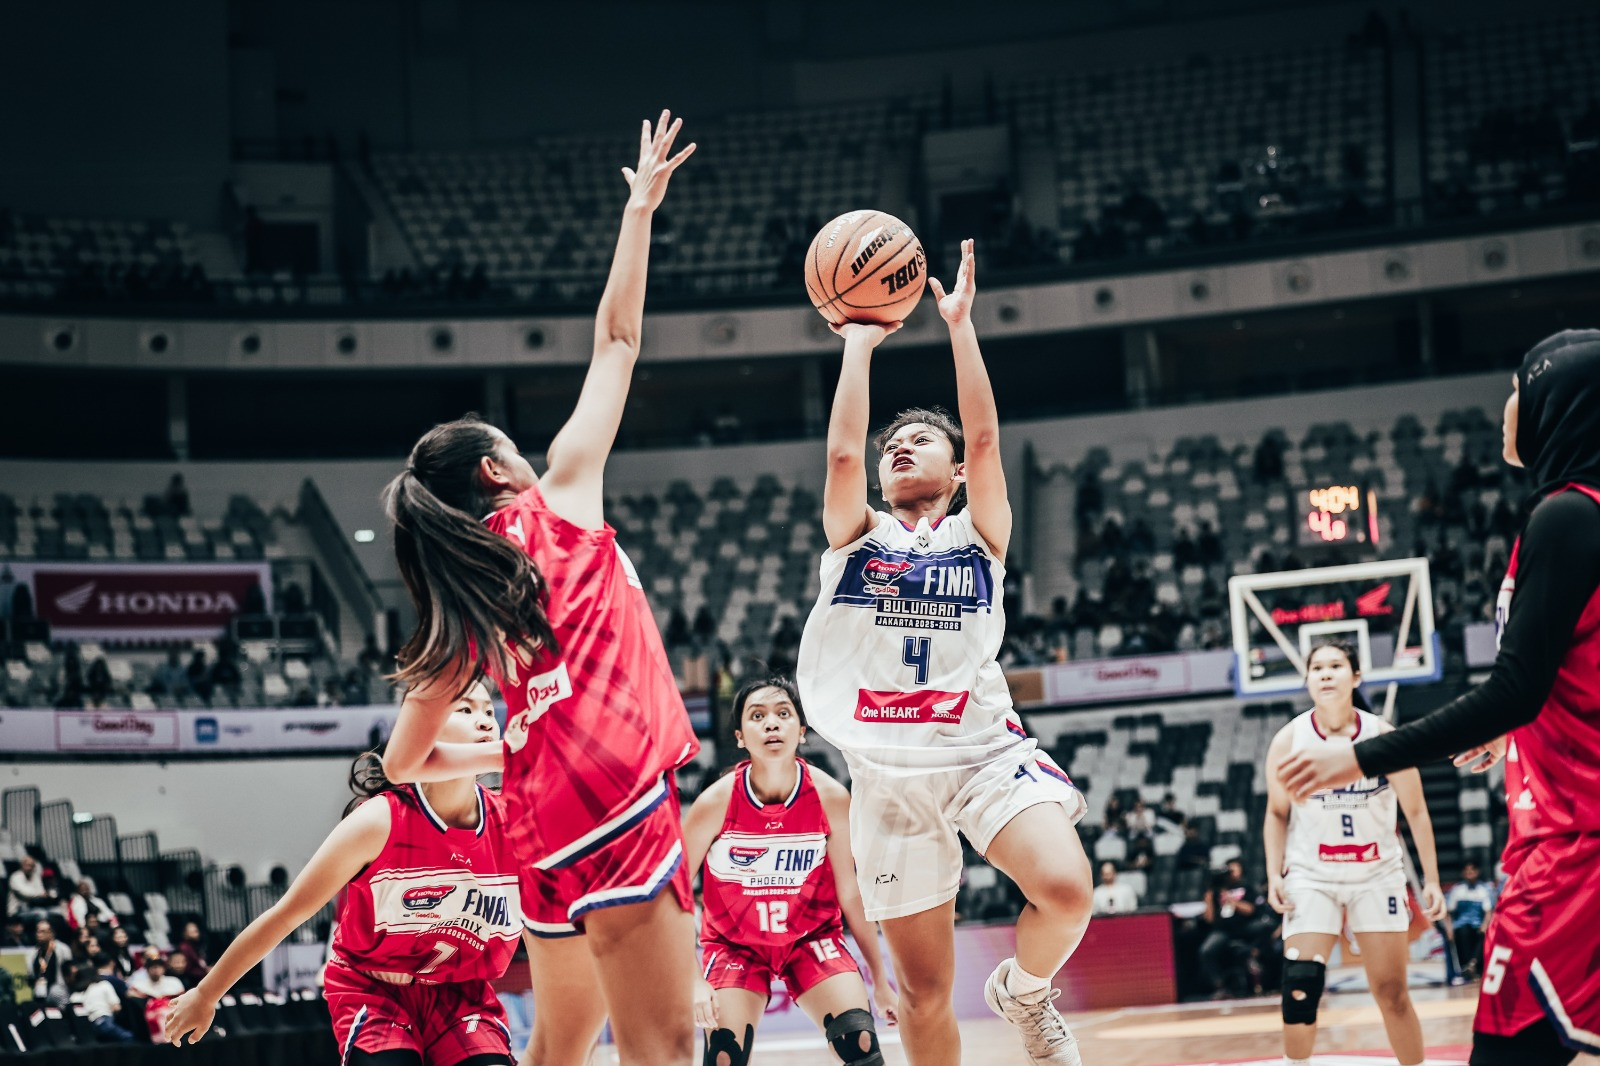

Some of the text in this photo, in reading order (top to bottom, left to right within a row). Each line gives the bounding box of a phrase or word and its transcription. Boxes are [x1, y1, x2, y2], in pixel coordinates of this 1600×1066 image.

[881, 264, 919, 296] DBL
[875, 572, 890, 581] DBL
[99, 591, 239, 614] HONDA
[883, 600, 956, 617] BULUNGAN
[877, 617, 959, 630] JAKARTA 2025-2026
[902, 636, 931, 685] 4
[861, 706, 878, 718] One
[931, 712, 961, 720] HONDA
[1341, 814, 1354, 837] 9
[775, 849, 819, 872] FINA
[750, 877, 795, 886] PHOENIX
[461, 889, 511, 927] FINAL
[1388, 896, 1397, 914] 9
[755, 900, 789, 934] 12
[416, 940, 459, 974] 7
[809, 938, 842, 963] 12
[1482, 944, 1513, 996] 5
[461, 1013, 481, 1034] 7
